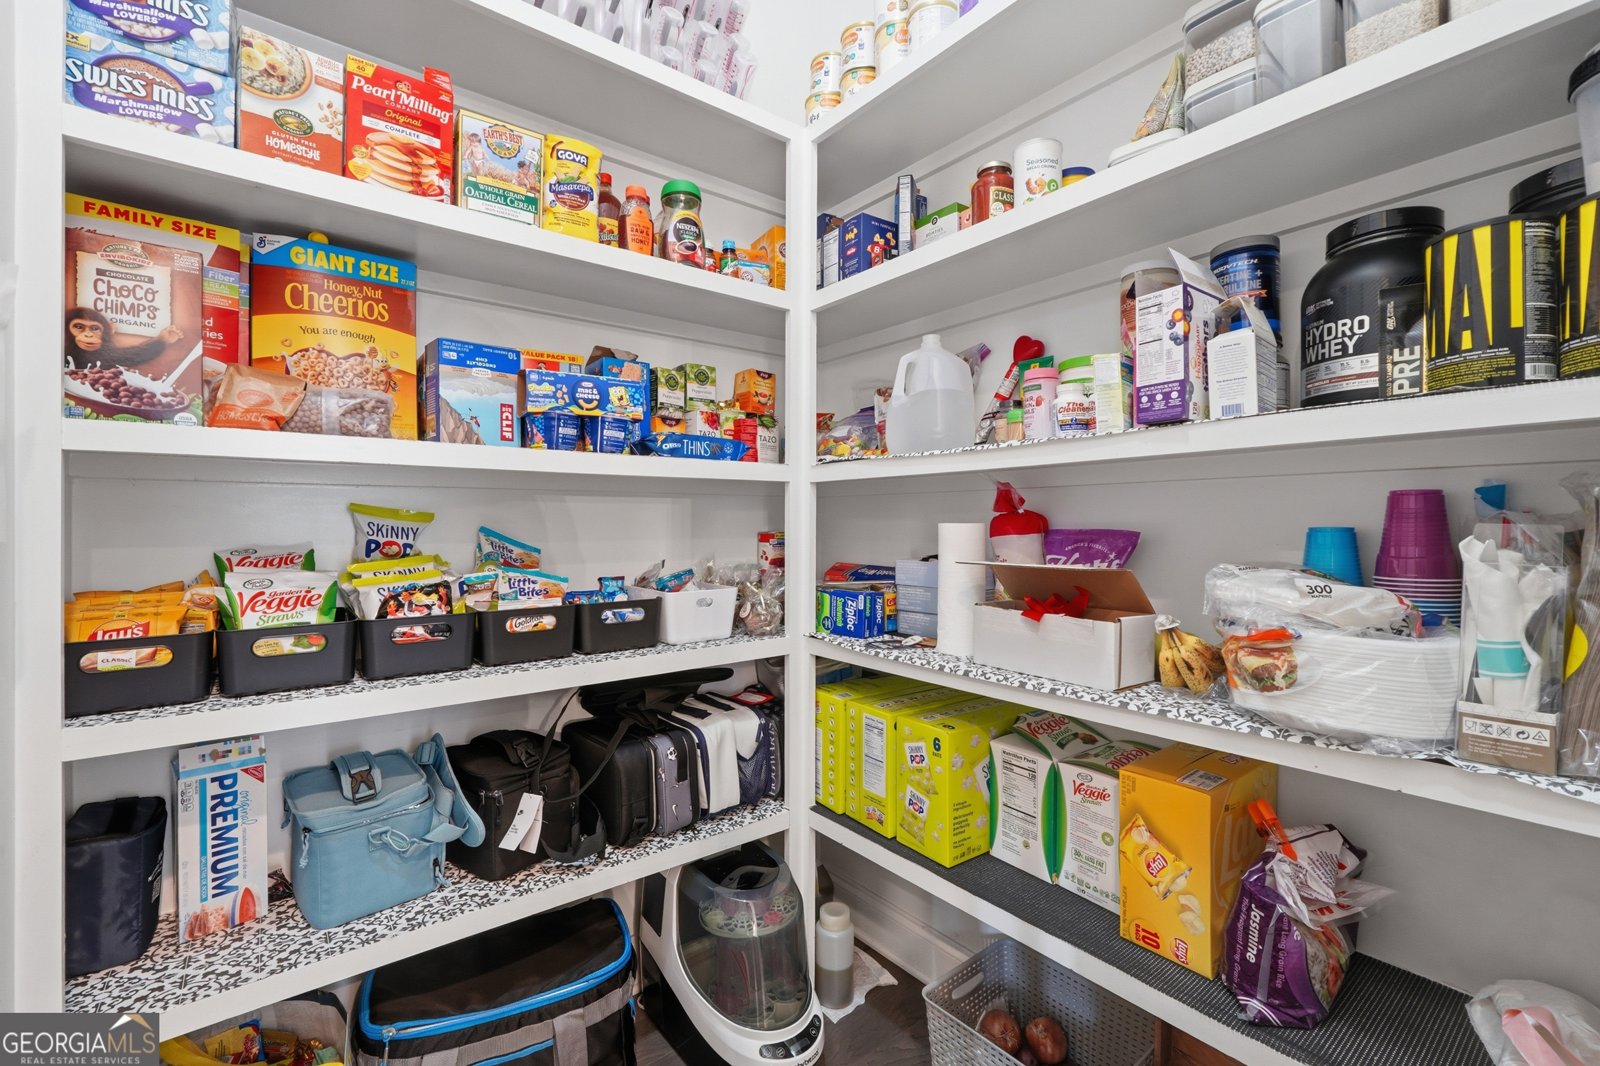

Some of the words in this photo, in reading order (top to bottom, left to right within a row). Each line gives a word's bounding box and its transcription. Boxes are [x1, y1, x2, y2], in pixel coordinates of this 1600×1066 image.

[89, 0, 177, 22] Marshmallow
[113, 9, 159, 24] LOVERS
[94, 93, 183, 118] Marshmallow
[352, 74, 395, 102] Pearl
[397, 89, 453, 125] Milling
[385, 99, 421, 116] COMPANY
[119, 106, 164, 120] LOVERS
[385, 109, 423, 127] Original
[271, 130, 300, 143] GLUTEN
[300, 137, 317, 147] FREE
[385, 124, 421, 140] COMPLETE
[483, 128, 508, 141] EARTH'S
[508, 132, 523, 145] BEST
[557, 149, 588, 166] GOYA
[1026, 157, 1059, 167] Seasoned
[478, 184, 504, 195] WHOLE
[505, 190, 526, 201] GRAIN
[551, 182, 592, 194] Masarepa
[993, 190, 1014, 203] CLASS
[84, 200, 164, 228] FAMILY
[171, 220, 217, 240] SIZE
[630, 227, 644, 235] RAW
[631, 237, 650, 246] HONEY
[290, 245, 355, 274] GIANT
[359, 260, 399, 284] SIZE
[105, 271, 150, 283] CHOCOLATE
[208, 270, 235, 283] Fiber
[324, 279, 359, 295] Honey
[362, 288, 383, 300] Nut
[284, 282, 389, 323] Cheerios
[110, 317, 157, 329] ORGANIC
[1306, 315, 1370, 348] HYDRO
[203, 328, 224, 340] ries
[299, 325, 320, 336] You
[322, 327, 338, 337] are
[340, 328, 376, 344] enough
[521, 351, 544, 360] VALUE
[545, 353, 567, 362] PACK
[1306, 334, 1361, 364] WHEY
[1393, 345, 1421, 396] PRE
[502, 412, 513, 440] CLIF
[758, 435, 777, 444] TAZO
[683, 440, 711, 457] THINS
[366, 522, 420, 542] SKINNY
[365, 539, 414, 559] POP
[490, 541, 514, 555] Little
[226, 554, 303, 572] Veggie
[501, 551, 525, 565] Bites
[508, 578, 538, 591] Little
[518, 586, 550, 597] Bites
[1306, 584, 1333, 594] 300
[237, 587, 323, 618] Veggie
[256, 610, 304, 627] Straws
[845, 600, 857, 631] Ziploc
[101, 657, 133, 665] CLASSIC
[1018, 714, 1071, 740] Veggie
[932, 737, 942, 752] 6
[910, 754, 926, 765] POP
[1002, 750, 1023, 761] Nutrition
[1072, 780, 1111, 802] Veggie
[232, 791, 258, 826] original
[908, 798, 924, 815] POP
[210, 772, 240, 899] PREMIUM
[1148, 854, 1168, 877] Lay's
[1241, 897, 1249, 914] Thai
[1140, 926, 1161, 951] 10
[1246, 903, 1265, 964] Jasmine
[1278, 931, 1289, 950] Long
[1174, 937, 1189, 965] Lay's
[1277, 950, 1287, 972] Grain
[1276, 973, 1286, 989] Rice
